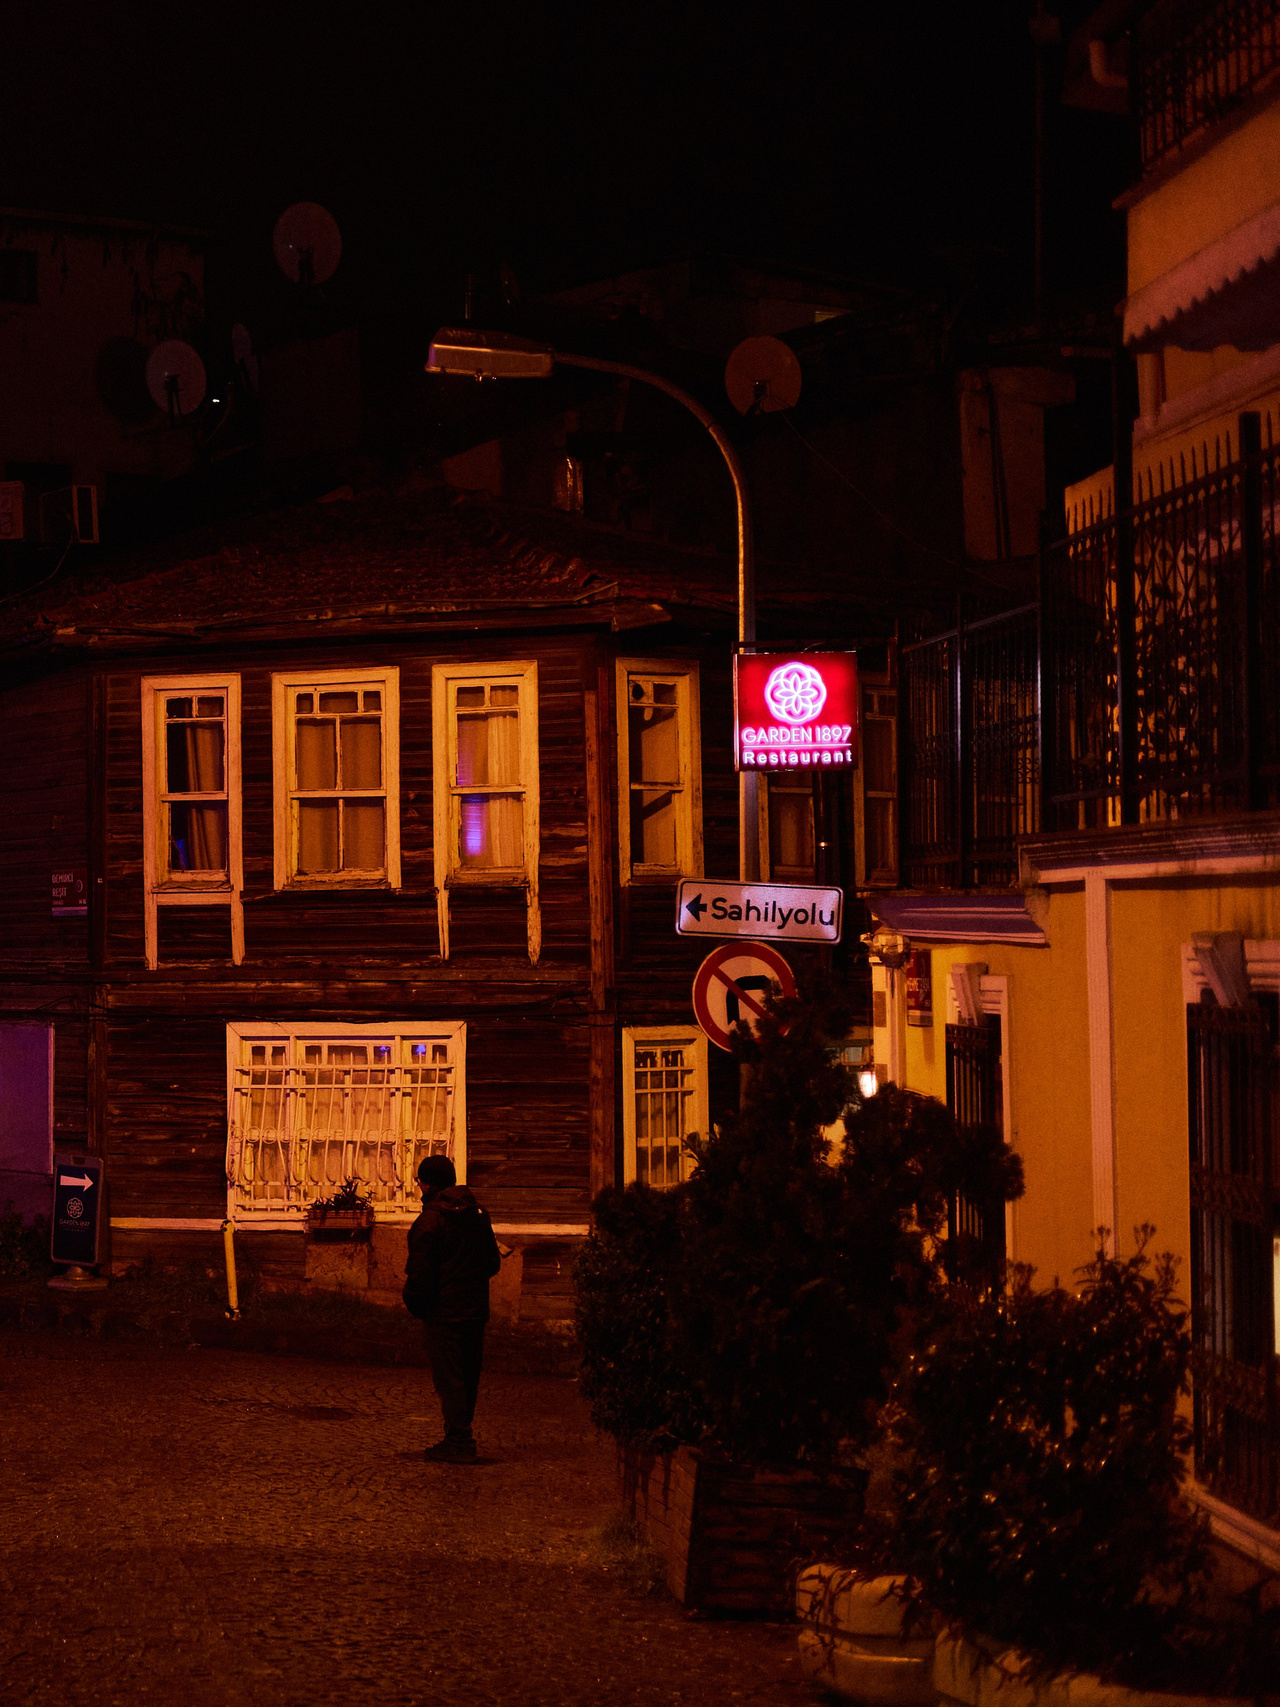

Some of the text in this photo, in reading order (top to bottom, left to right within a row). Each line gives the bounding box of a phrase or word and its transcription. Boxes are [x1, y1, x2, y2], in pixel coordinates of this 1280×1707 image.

[742, 725, 852, 743] GARDEN 1897
[743, 749, 853, 764] Restaurant
[711, 897, 835, 929] Sahilyolu
